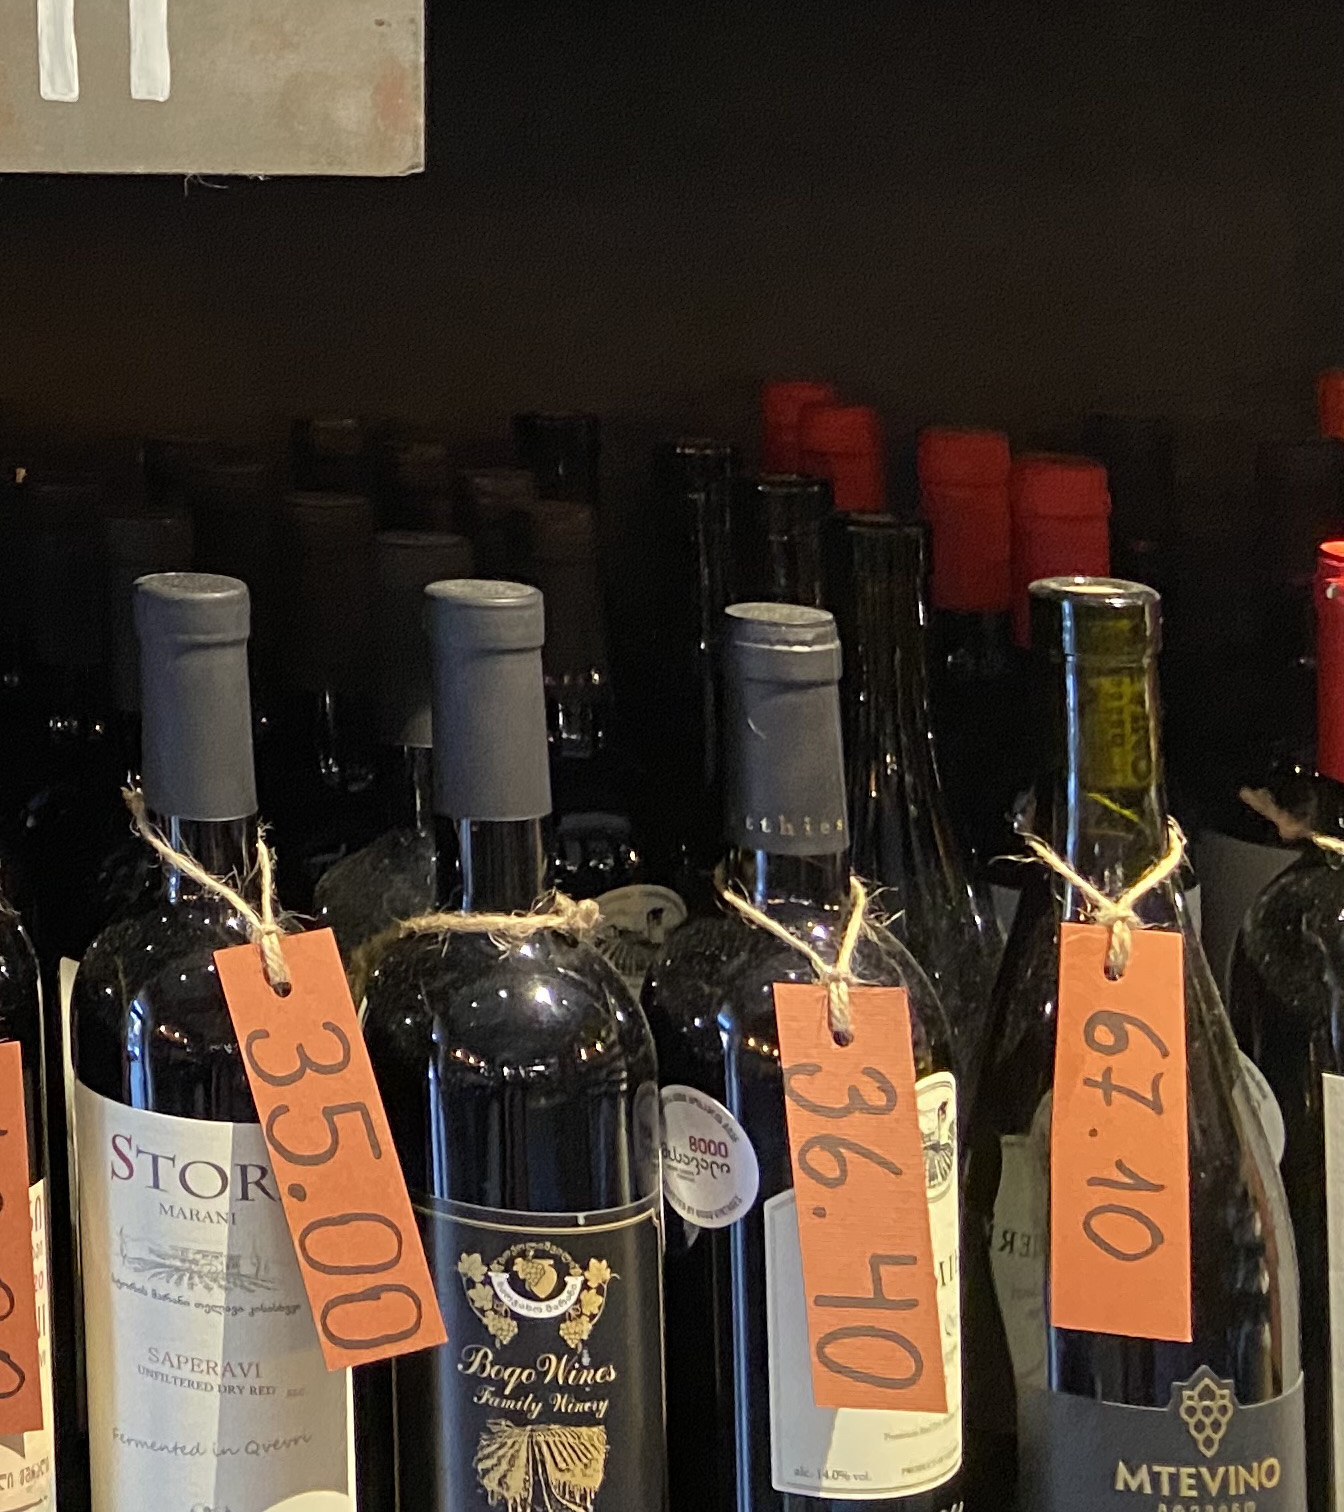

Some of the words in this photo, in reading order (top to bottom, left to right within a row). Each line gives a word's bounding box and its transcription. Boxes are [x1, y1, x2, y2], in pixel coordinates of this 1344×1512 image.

[688, 1135, 729, 1159] 8000
[1083, 1010, 1170, 1263] 67.10
[246, 1020, 423, 1351] 35.00
[159, 1202, 238, 1227] MARANI
[784, 1063, 924, 1389] 36.40
[148, 1346, 264, 1380] SAPERAVI
[536, 1352, 616, 1385] Wines
[137, 1364, 214, 1394] UNFILTERED
[217, 1383, 246, 1396] DRY
[249, 1385, 276, 1397] RED
[473, 1385, 543, 1420] Family
[548, 1392, 610, 1421] Winery
[113, 1428, 206, 1457] Fermented
[212, 1443, 240, 1458] in
[1115, 1457, 1281, 1498] MTEVINO
